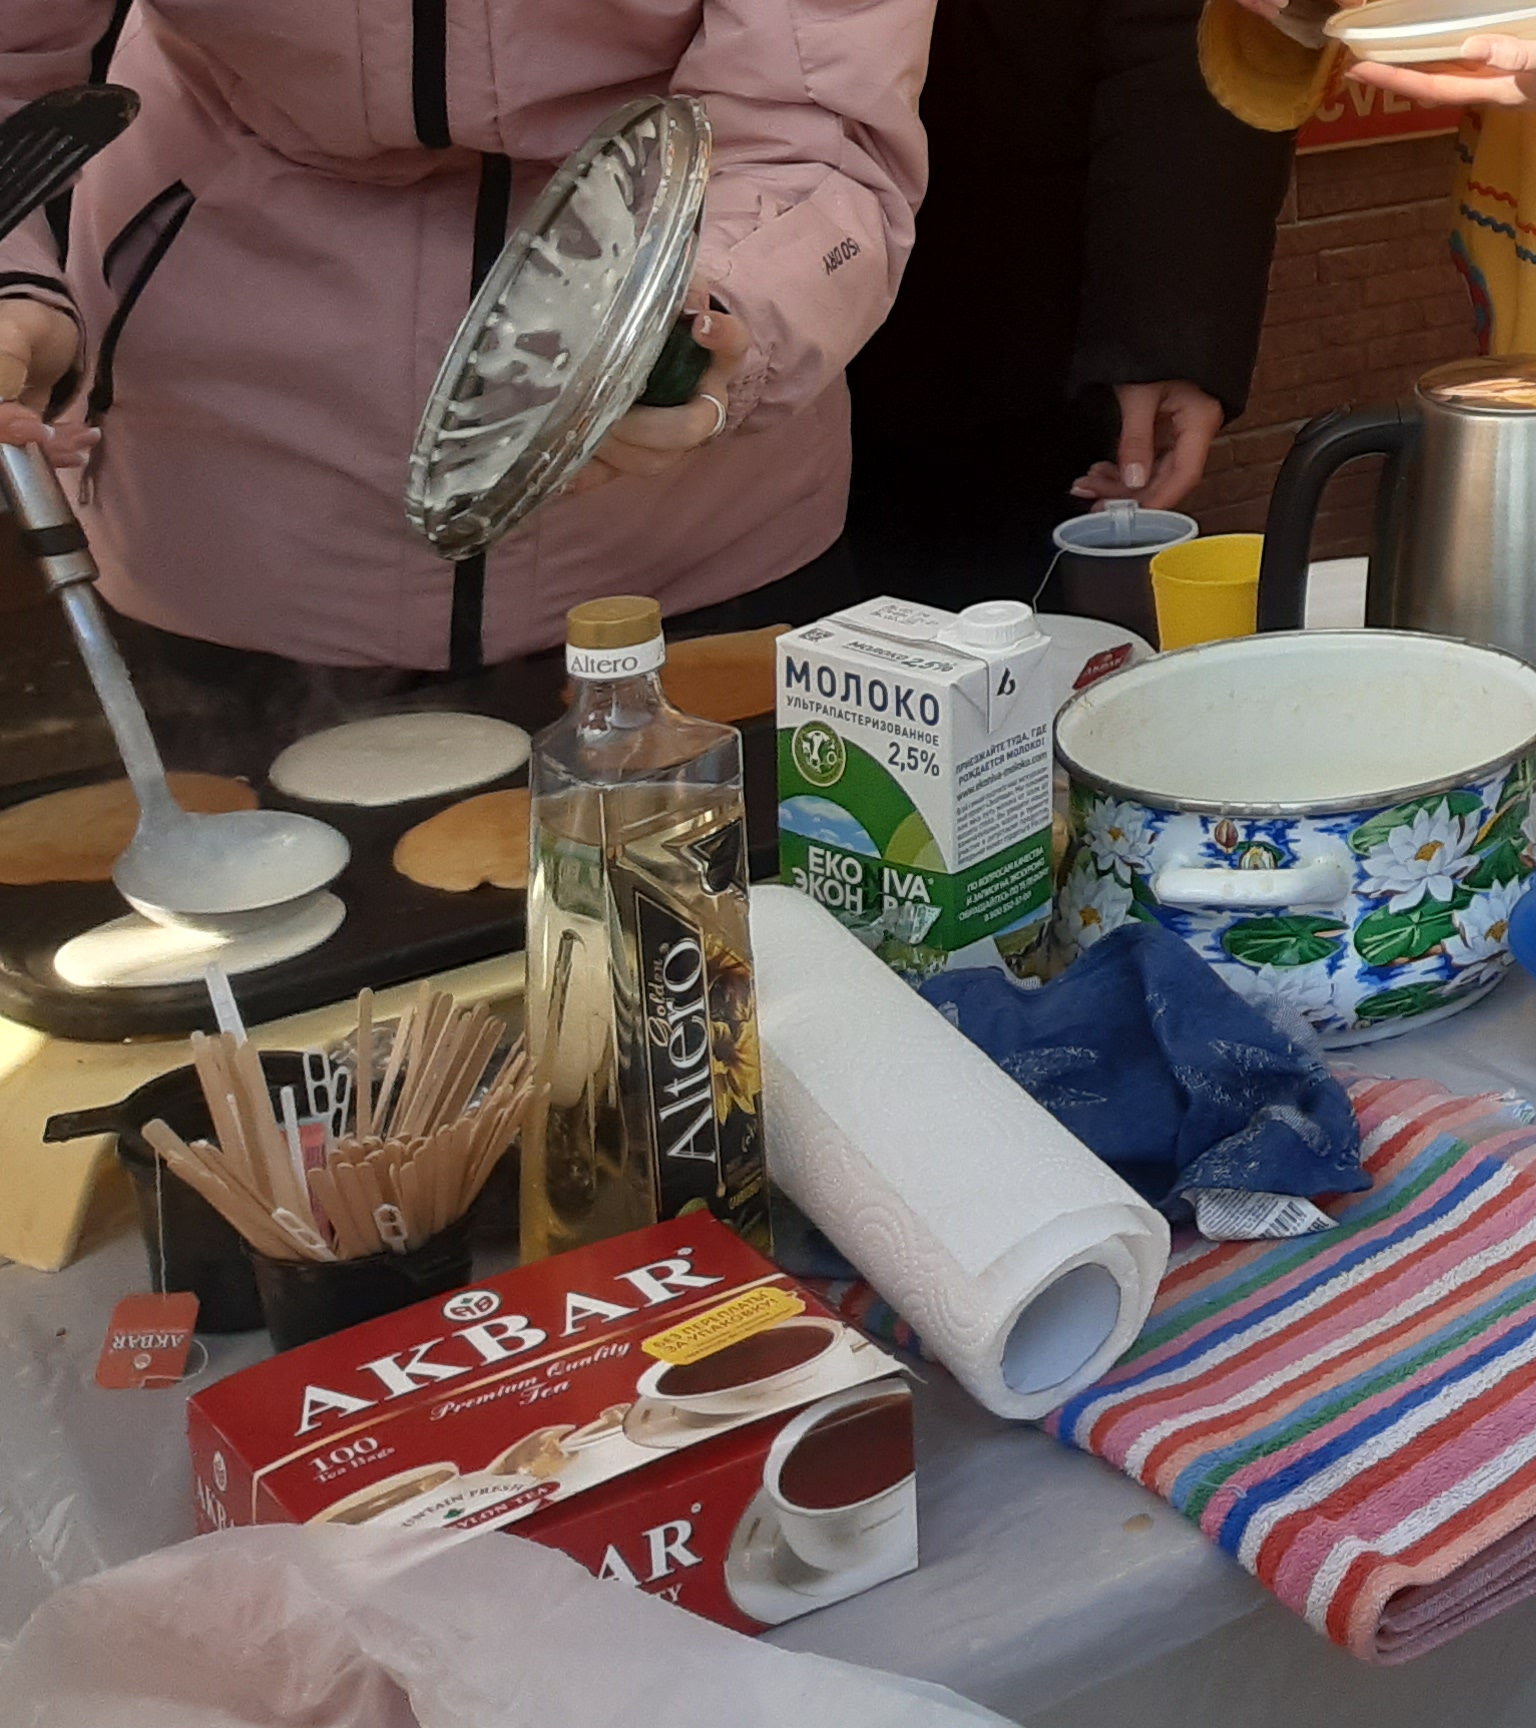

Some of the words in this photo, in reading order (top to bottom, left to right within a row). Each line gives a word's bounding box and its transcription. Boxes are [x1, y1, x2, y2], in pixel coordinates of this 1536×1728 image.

[570, 655, 639, 674] Altero
[785, 656, 940, 727] МОЛОКО
[786, 695, 940, 747] УЛЬТРАПАСТЕРИЗОВАННОЕ
[888, 741, 940, 777] 2,5%
[648, 957, 672, 1048] Golden
[660, 937, 717, 1165] Altero
[112, 1333, 186, 1351] AKBAR
[294, 1256, 725, 1437] AKBAR
[429, 1375, 538, 1421] Premium
[546, 1341, 631, 1378] Quality
[519, 1379, 571, 1406] Tea
[309, 1436, 379, 1473] 100
[597, 1518, 704, 1586] AR
